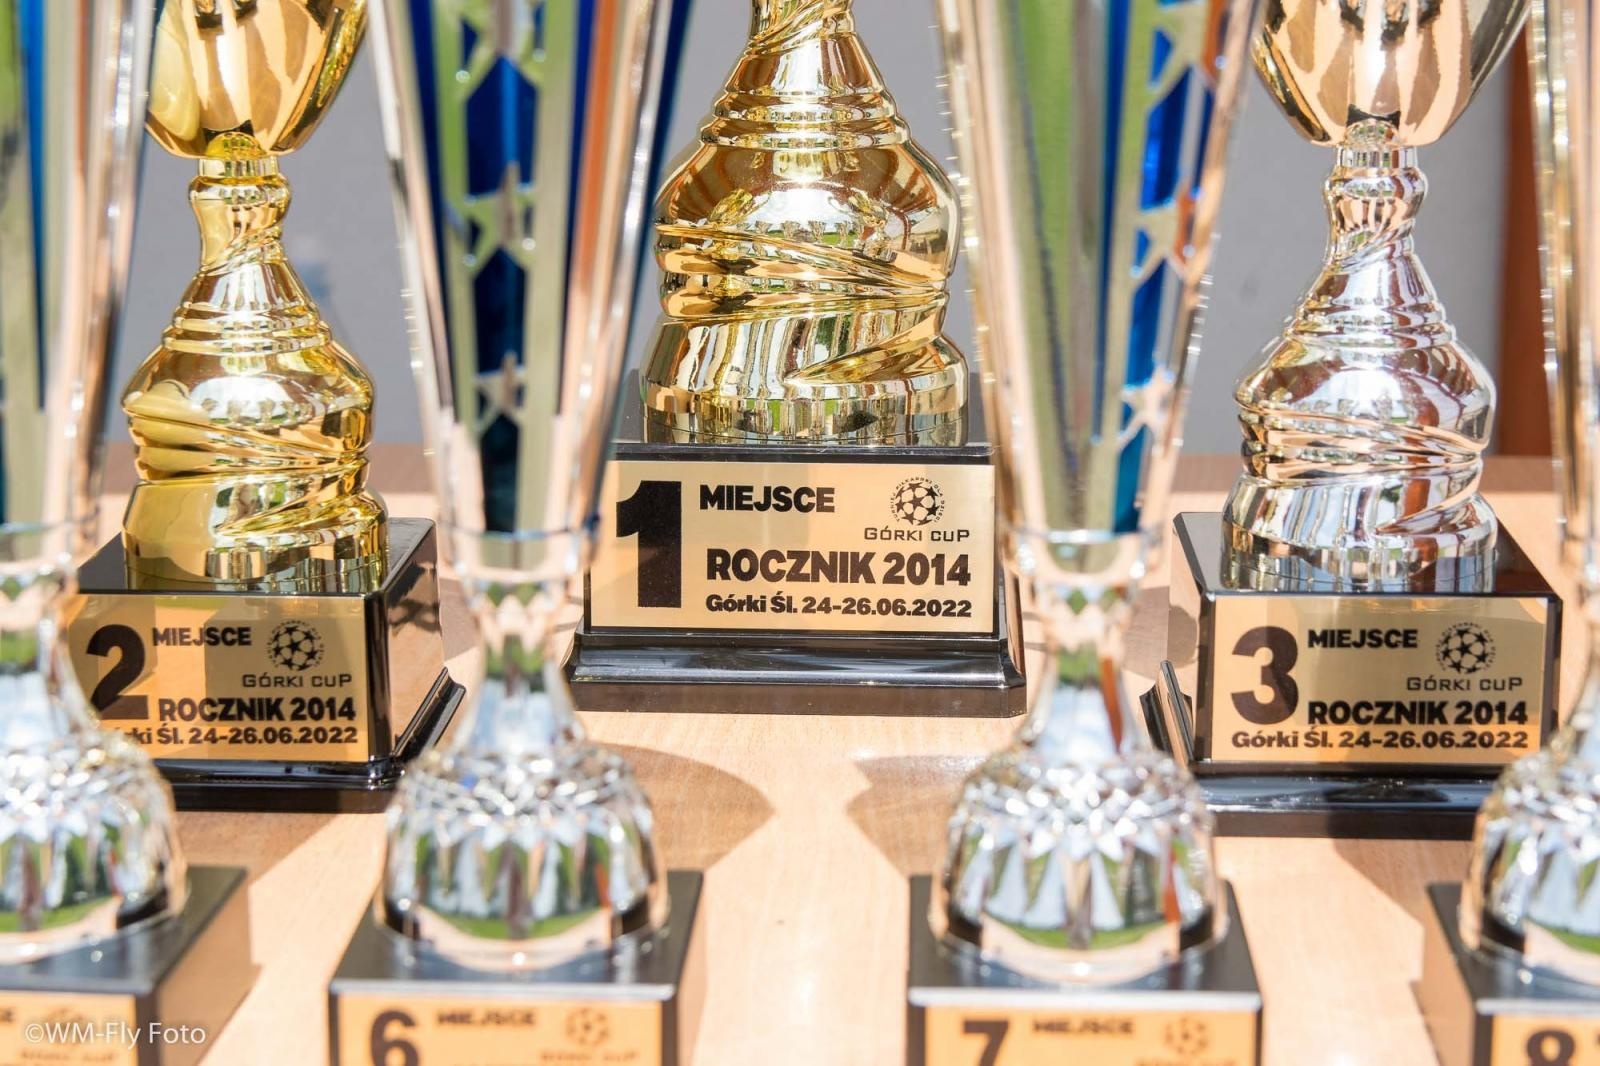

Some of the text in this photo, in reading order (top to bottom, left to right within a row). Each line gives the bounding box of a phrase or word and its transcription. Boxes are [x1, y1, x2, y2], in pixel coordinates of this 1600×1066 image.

[616, 480, 835, 608] 1 MIEJSCE
[864, 525, 922, 541] GÓRKI
[707, 548, 971, 586] ROCZNIK 2014
[706, 591, 972, 618] Górki Śl. 24-26.06.2022
[86, 624, 148, 720] 2
[152, 627, 252, 647] MIEJSCE
[242, 672, 304, 688] GÓRKI
[1230, 626, 1299, 725] 3
[1308, 629, 1418, 649] MIEJSCE
[1407, 674, 1470, 691] GÓRKI
[159, 697, 356, 721] ROCZNIK 2014
[1308, 701, 1528, 725] ROCZNIK 2014
[157, 723, 184, 744] Śl.
[188, 726, 357, 744] 24-26.06.2022
[1231, 725, 1528, 748] Górki Śl. 24-26.06.2022
[370, 1010, 419, 1066] 6
[963, 1020, 1010, 1066] 7
